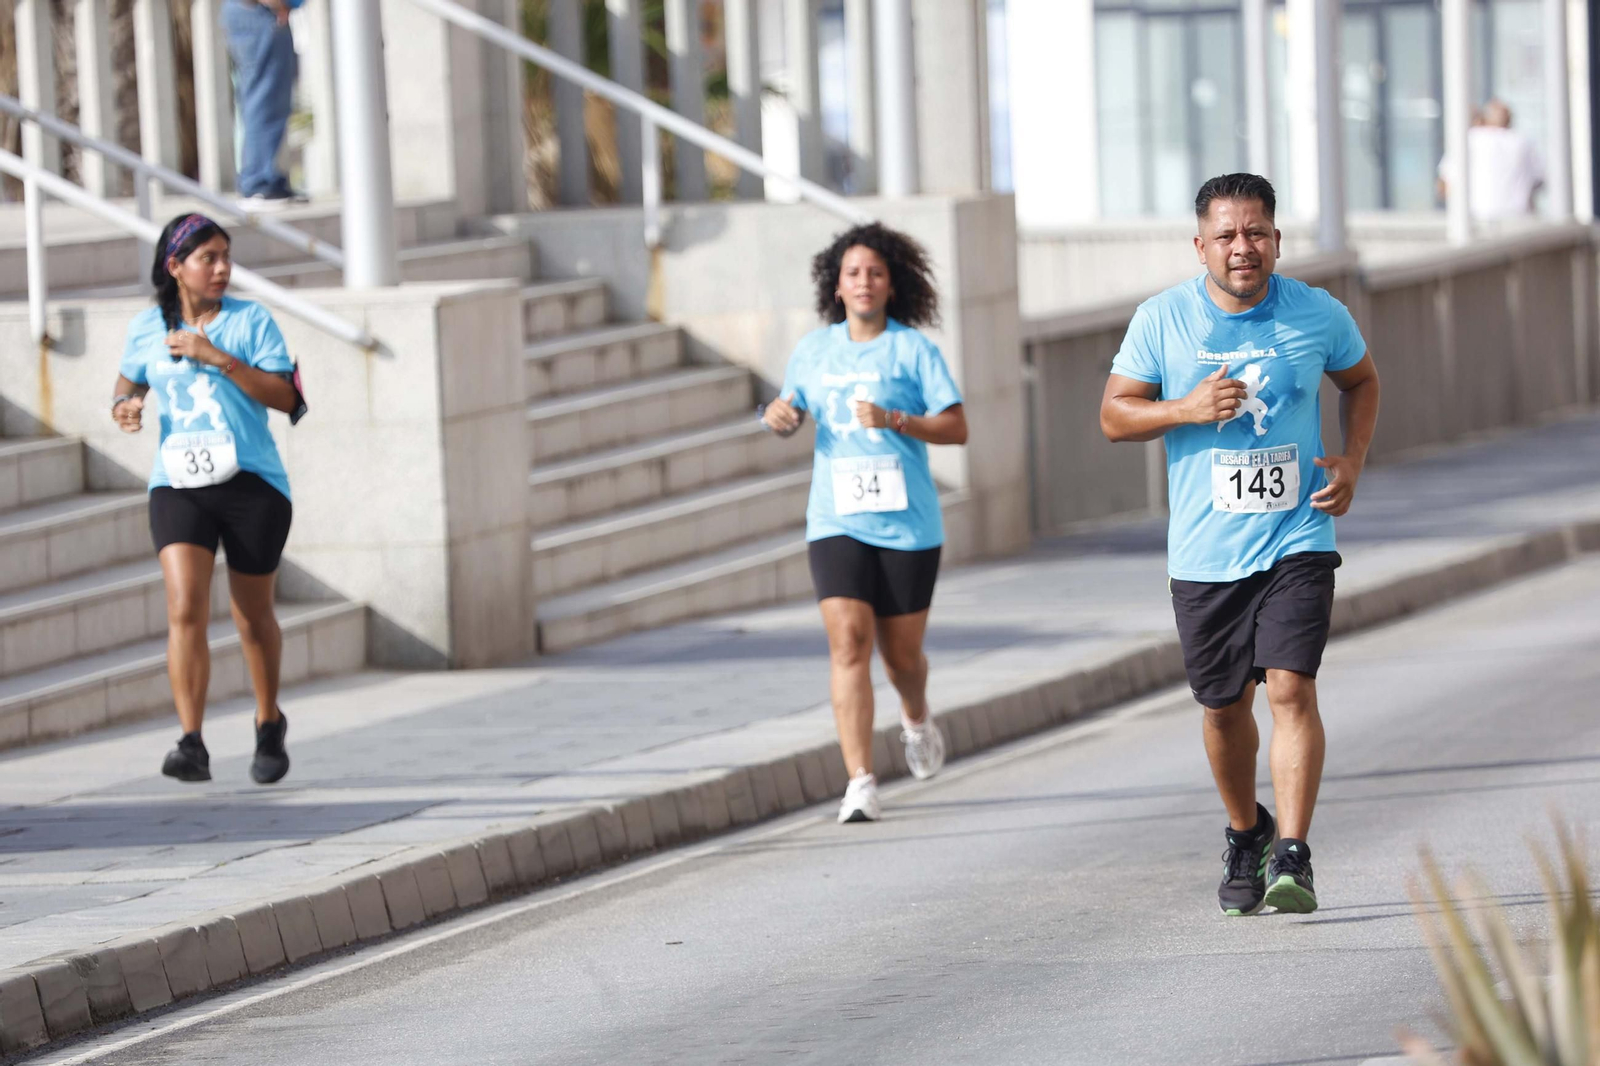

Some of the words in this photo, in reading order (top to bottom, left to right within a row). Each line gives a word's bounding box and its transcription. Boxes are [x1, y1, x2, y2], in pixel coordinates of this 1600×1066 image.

[1250, 347, 1277, 358] ELA
[184, 449, 214, 475] 33
[1251, 452, 1270, 467] ELA
[1270, 450, 1292, 463] TARIFA
[852, 474, 881, 500] 34
[1229, 466, 1285, 500] 143
